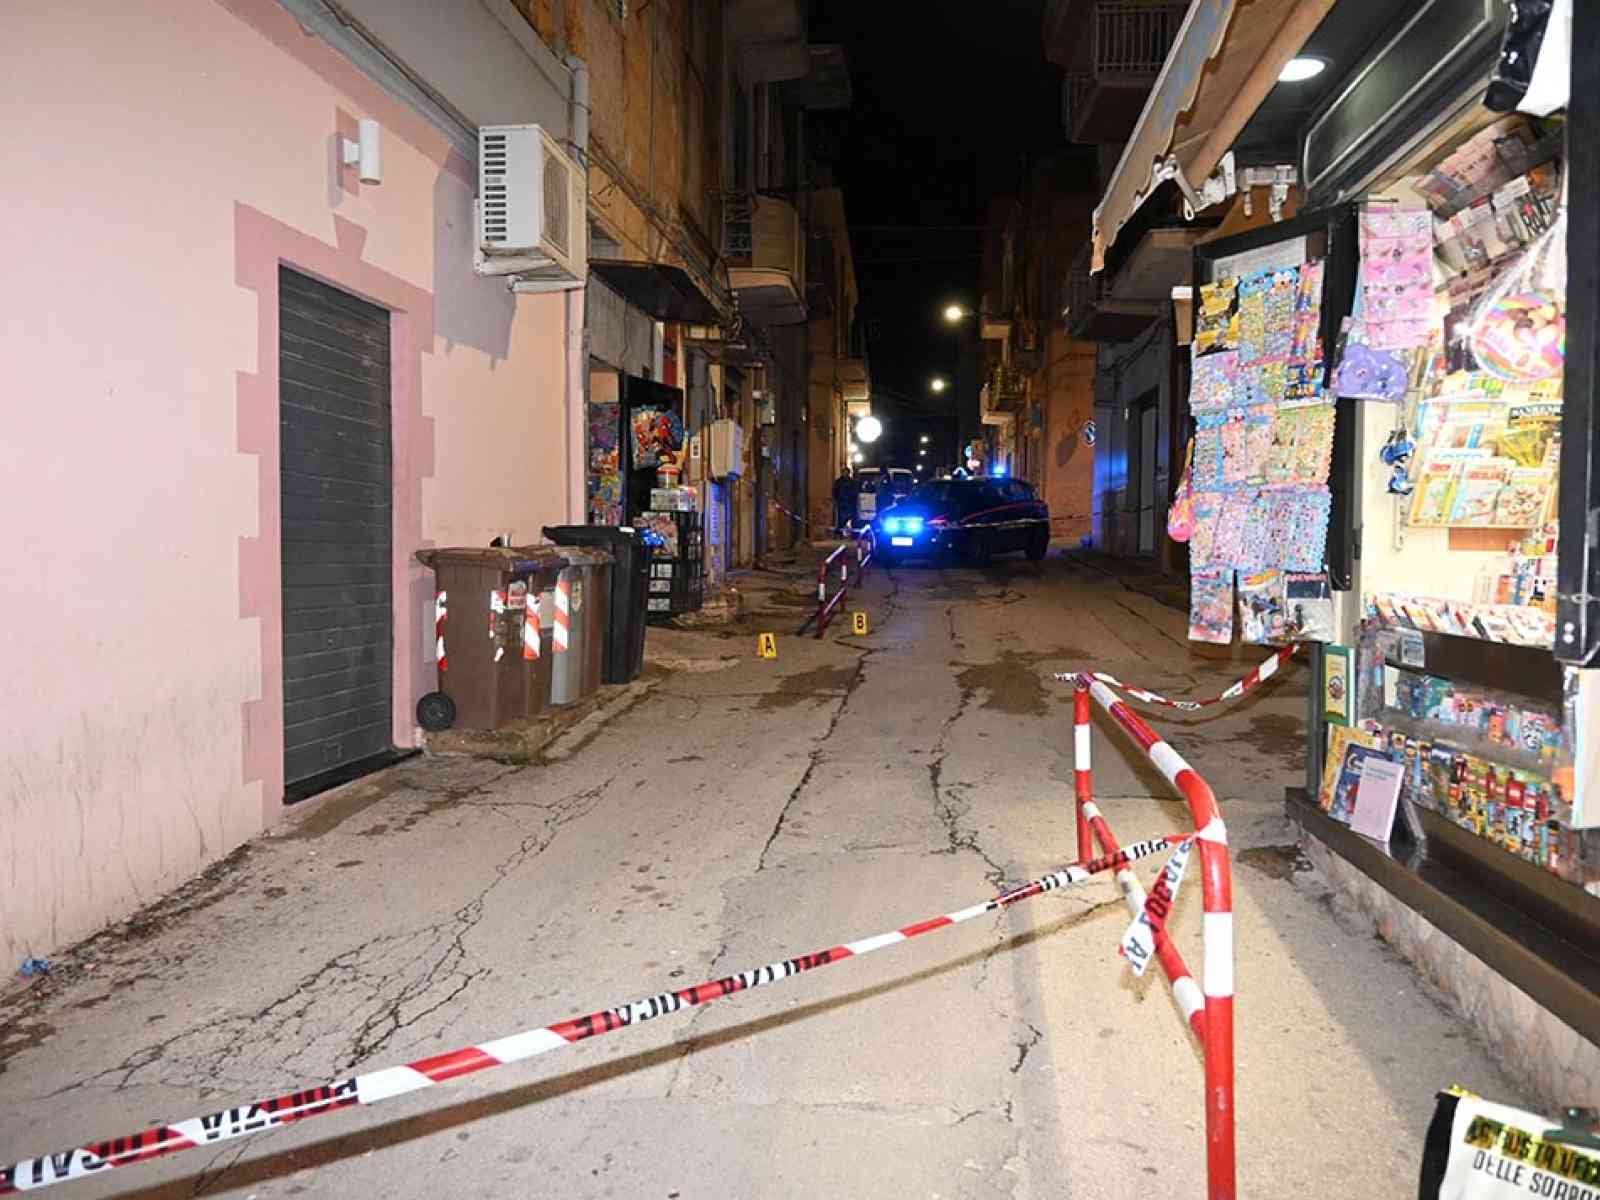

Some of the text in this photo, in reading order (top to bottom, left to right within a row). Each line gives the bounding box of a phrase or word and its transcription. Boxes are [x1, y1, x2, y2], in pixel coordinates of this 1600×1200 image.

[856, 615, 865, 629] B
[765, 635, 774, 653] A
[200, 1077, 360, 1141] POLIZIA
[1473, 1150, 1526, 1187] DELLE
